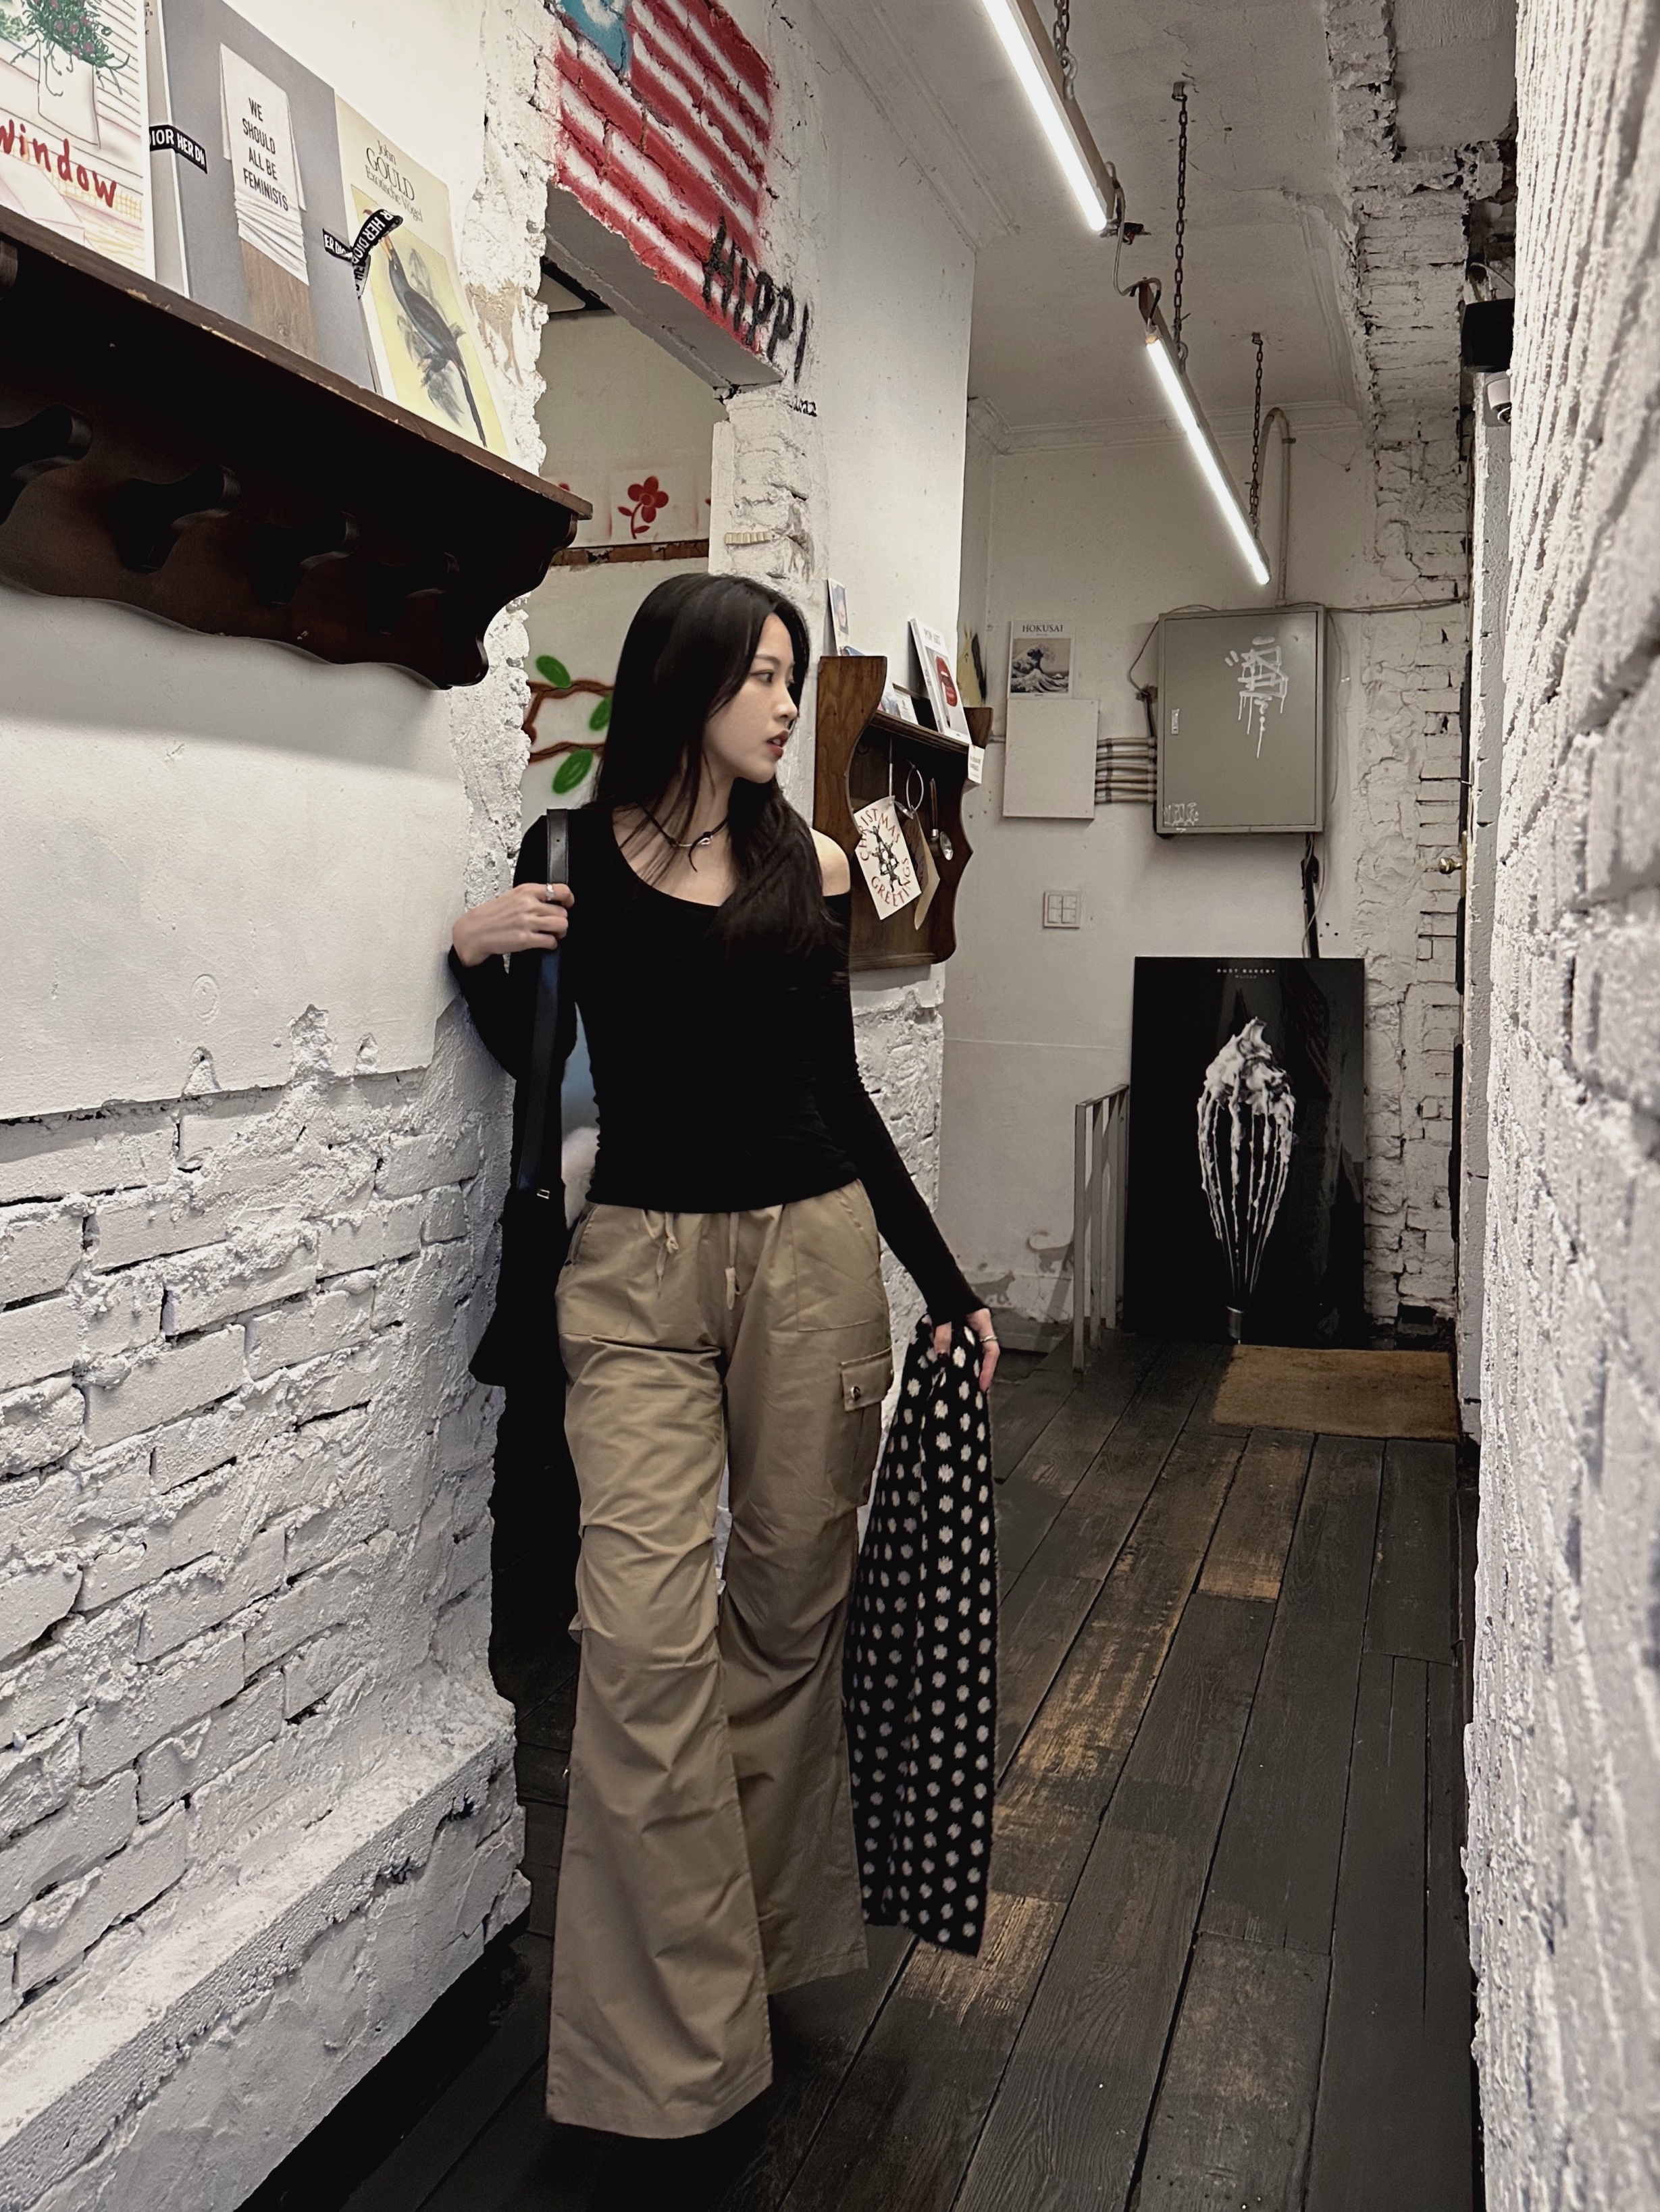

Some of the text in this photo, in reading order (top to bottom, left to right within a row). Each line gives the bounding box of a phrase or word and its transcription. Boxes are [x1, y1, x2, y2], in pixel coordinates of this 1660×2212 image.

[248, 97, 263, 122] WE
[177, 132, 194, 158] HER
[242, 117, 276, 155] SHOULD
[377, 139, 397, 166] John
[249, 147, 278, 181] ALL BE
[366, 147, 415, 201] GOULD
[242, 167, 289, 212] FEMINISTS
[362, 216, 386, 242] HER
[1022, 624, 1064, 633] HOKUSAI
[859, 808, 901, 862] CHRISTMAS
[871, 858, 913, 907] GREETINGS
